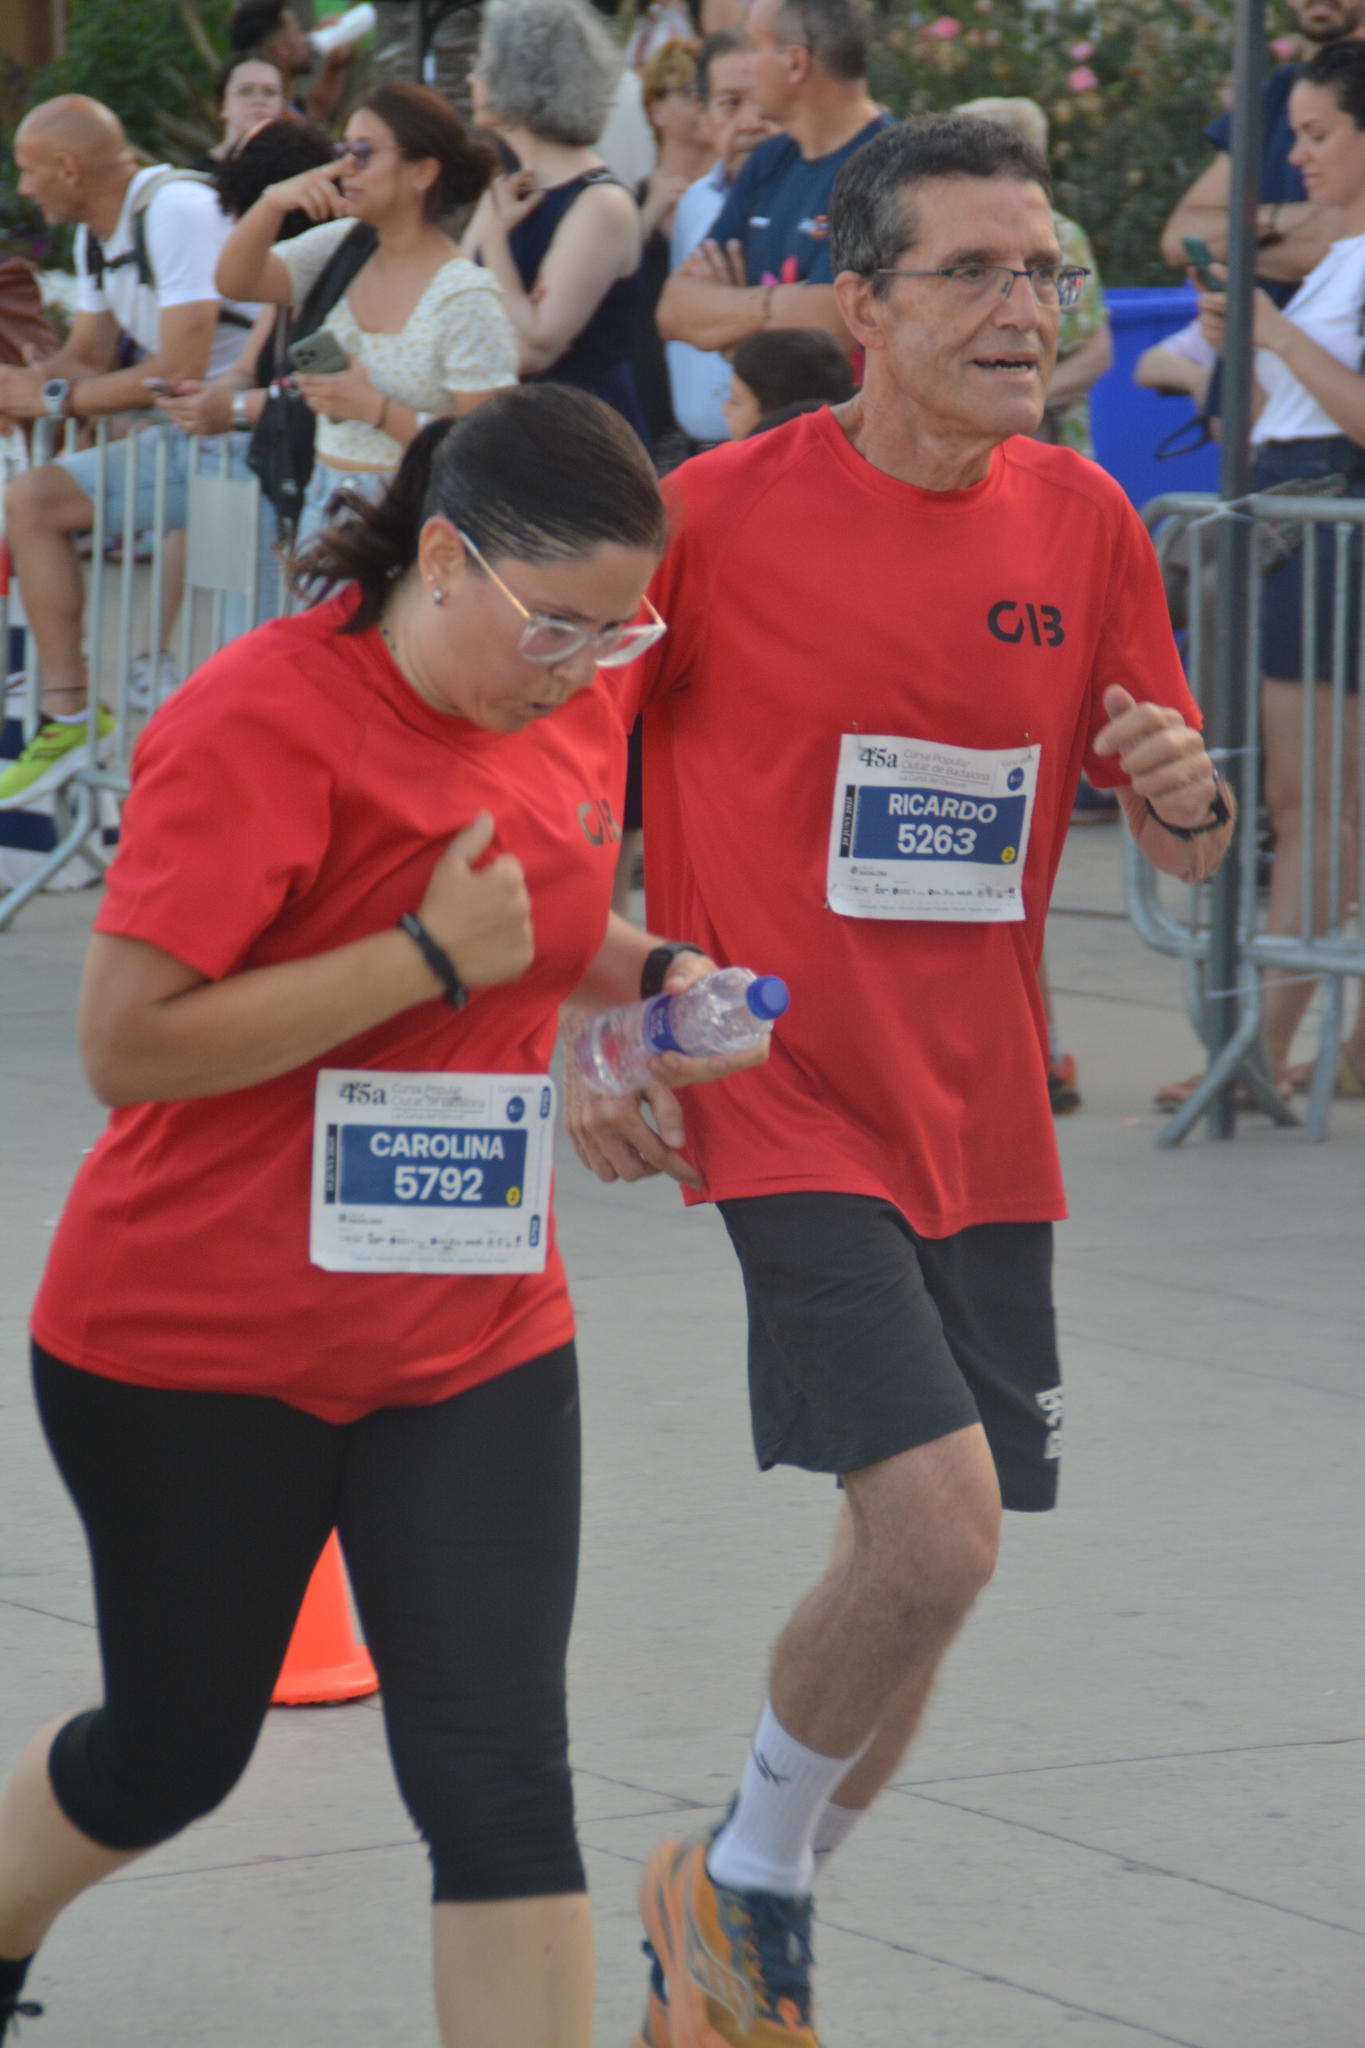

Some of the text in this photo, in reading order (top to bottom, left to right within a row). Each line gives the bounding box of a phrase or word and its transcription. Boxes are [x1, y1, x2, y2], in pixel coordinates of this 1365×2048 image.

[858, 747, 898, 768] 45a
[888, 793, 998, 824] RICARDO
[897, 823, 978, 856] 5263
[369, 1131, 505, 1160] CAROLINA
[393, 1165, 484, 1201] 5792
